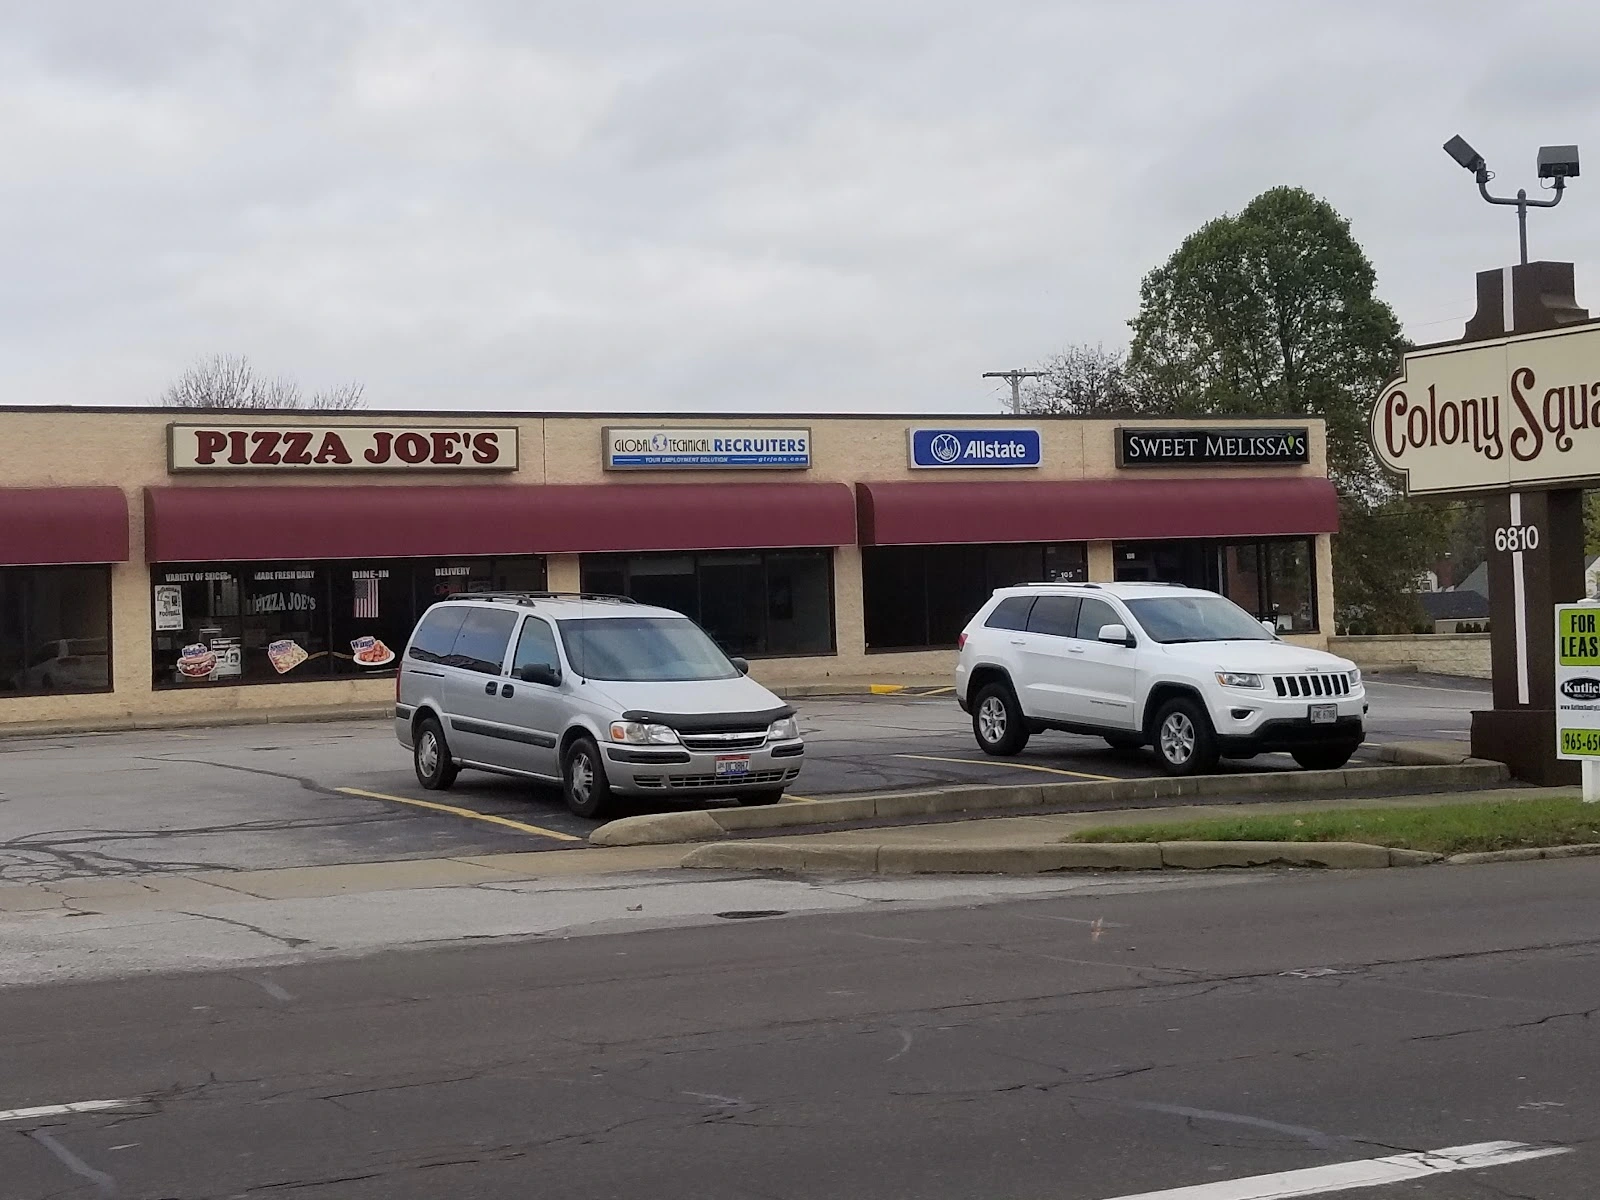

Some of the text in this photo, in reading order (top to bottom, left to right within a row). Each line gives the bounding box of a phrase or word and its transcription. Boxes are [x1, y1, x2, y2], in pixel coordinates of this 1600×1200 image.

[1385, 383, 1503, 460] Colony
[194, 430, 500, 465] PIZZA JOE'S
[614, 438, 806, 453] GLOBAL TECHNICAL RECRUITERS
[963, 440, 1026, 459] Allstate
[1129, 433, 1305, 457] SWEET MELISSA'S
[1494, 525, 1539, 552] 6810
[165, 572, 194, 581] VARIETY
[194, 572, 205, 581] OF
[254, 570, 315, 580] MADE FRESH DAILY
[352, 570, 389, 579] DINE-IN
[434, 566, 471, 576] DELIVERY
[255, 592, 317, 612] PIZZA JOE'S
[1570, 614, 1596, 633] FOR
[1561, 636, 1600, 658] LEAS
[1563, 682, 1600, 694] Kutlic
[1564, 732, 1600, 751] 965-65
